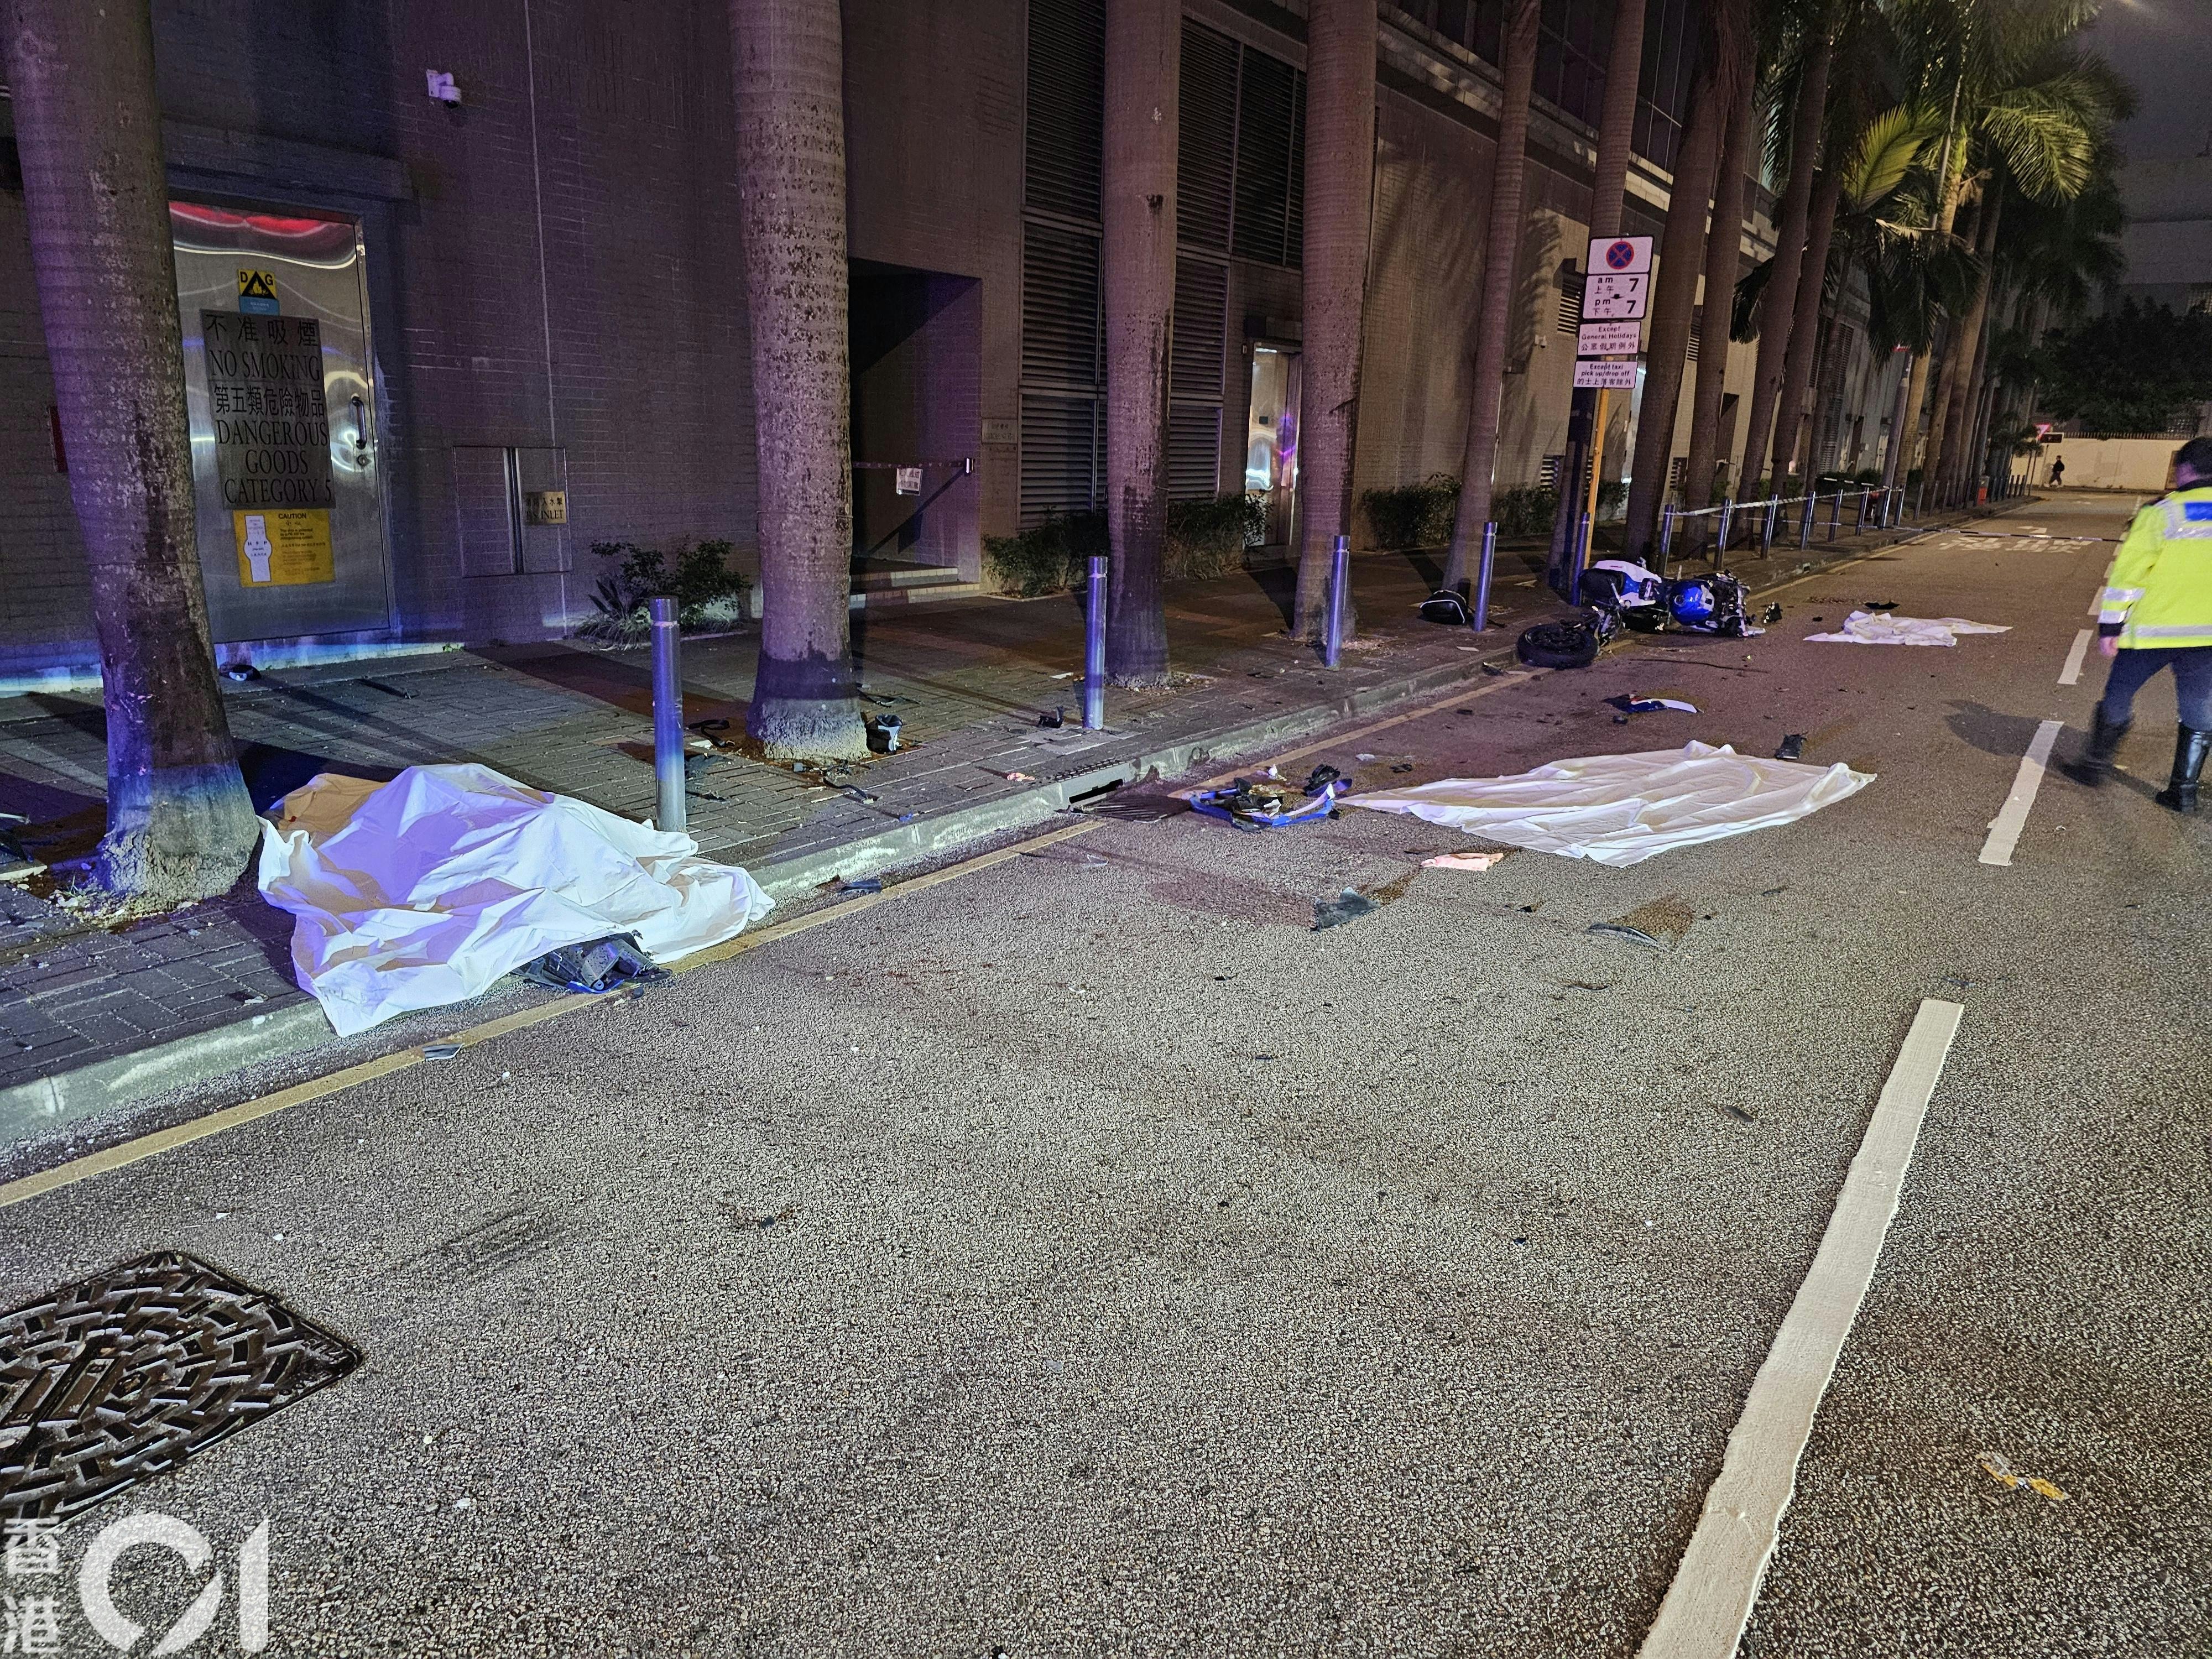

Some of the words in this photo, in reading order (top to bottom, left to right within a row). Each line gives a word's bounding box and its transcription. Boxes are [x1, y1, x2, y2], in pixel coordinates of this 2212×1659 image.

[240, 272, 248, 283] D
[265, 274, 273, 285] G
[1629, 278, 1639, 292] 7
[1594, 285, 1614, 294] 上午
[1593, 307, 1611, 316] 下午
[1626, 300, 1636, 314] 7
[206, 314, 319, 347] 不准吸煙
[210, 350, 237, 378] NO
[242, 351, 320, 382] SMOKING
[213, 384, 325, 417] 第五類危險物品
[216, 419, 328, 446] DANGEROUS
[245, 449, 309, 474] GOODS
[224, 478, 317, 504] CATEGORY
[325, 479, 332, 503] 5
[541, 509, 564, 519] INLET
